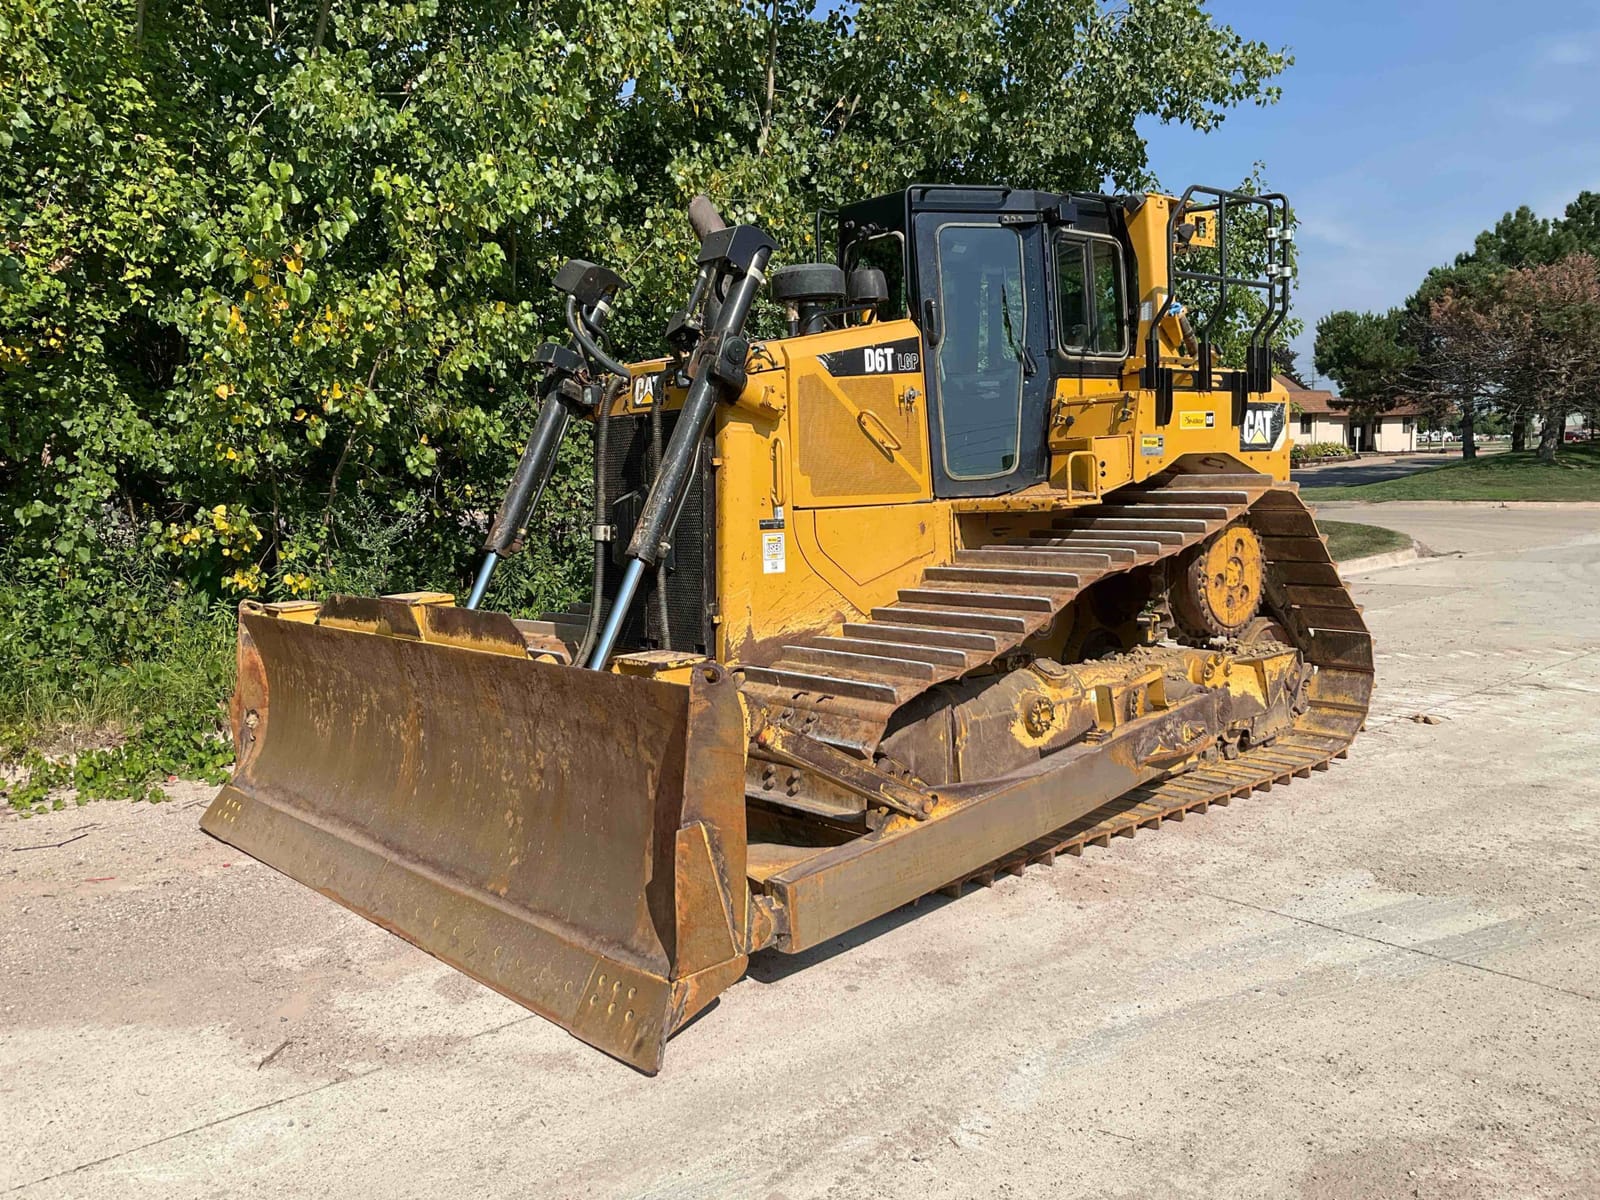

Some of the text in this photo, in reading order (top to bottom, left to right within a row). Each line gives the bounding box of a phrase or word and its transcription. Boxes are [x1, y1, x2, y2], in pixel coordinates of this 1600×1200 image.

[863, 347, 919, 373] D6T LGP
[1243, 409, 1273, 444] CAT
